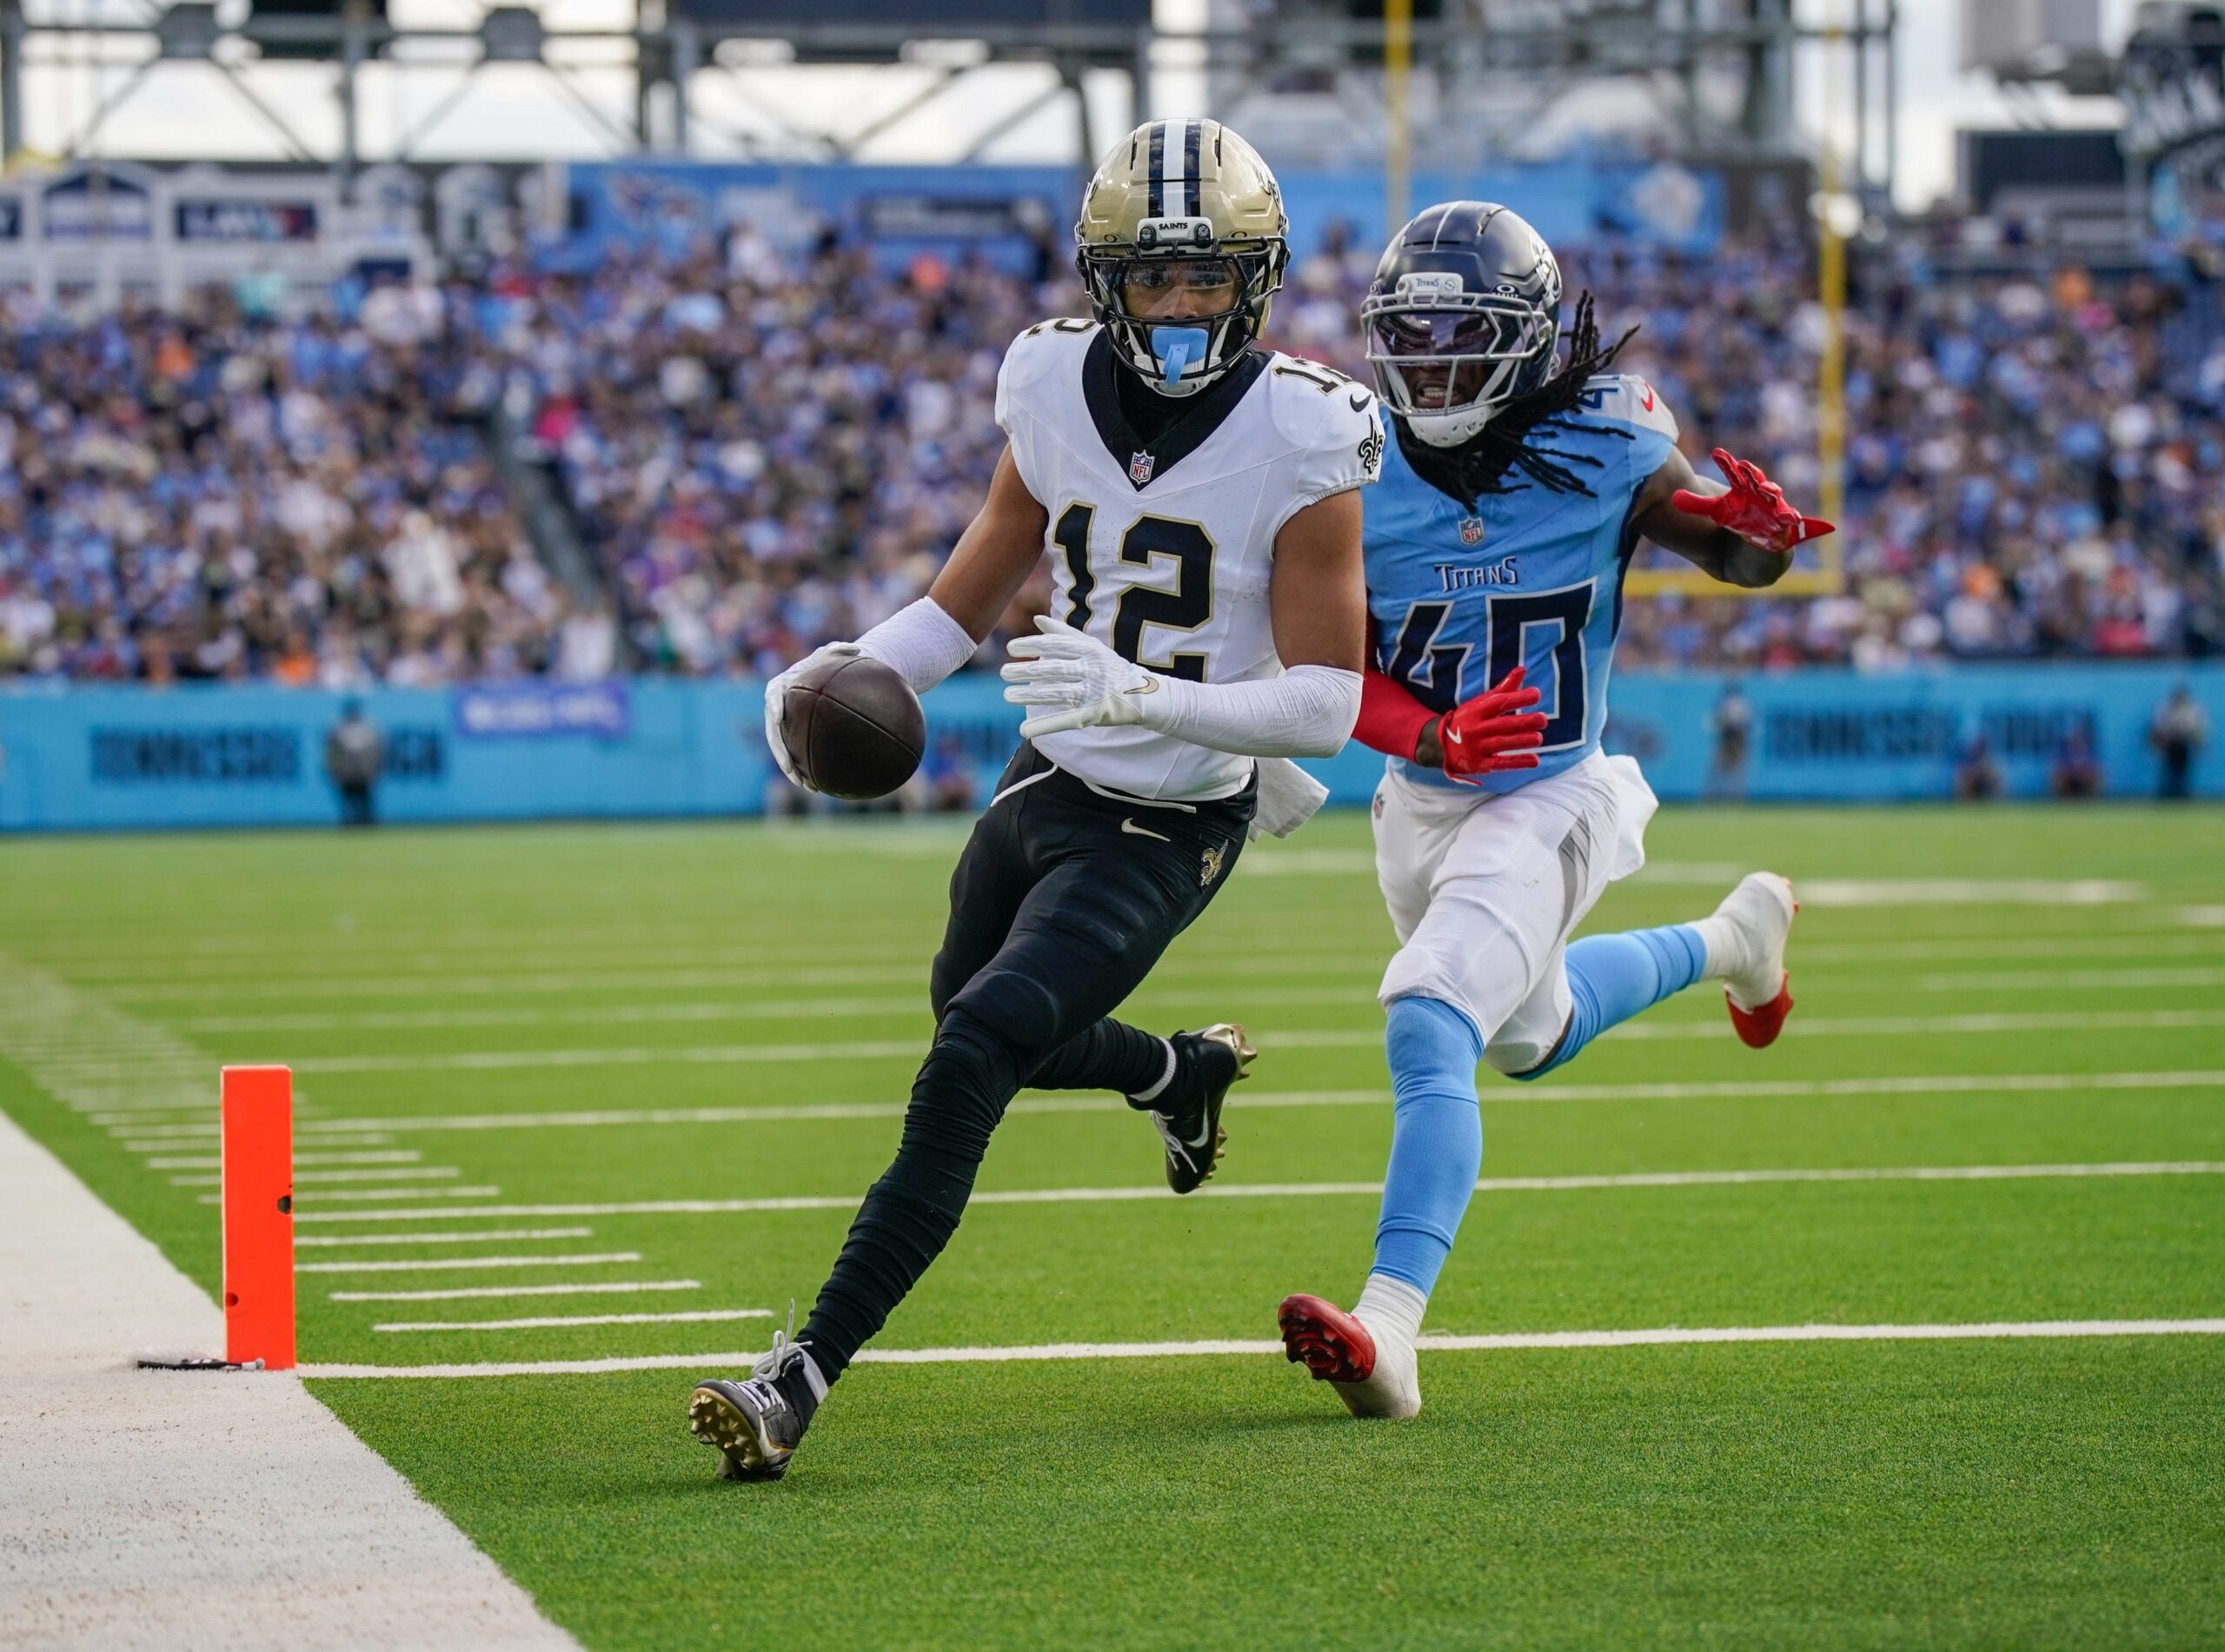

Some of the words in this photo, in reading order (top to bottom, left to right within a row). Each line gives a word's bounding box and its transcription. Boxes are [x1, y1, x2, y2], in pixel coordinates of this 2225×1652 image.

[1132, 464, 1148, 478] NFL
[1464, 528, 1482, 541] NFL
[1052, 499, 1218, 683] 12
[1434, 556, 1519, 594] TITANS
[1388, 575, 1599, 755] 40
